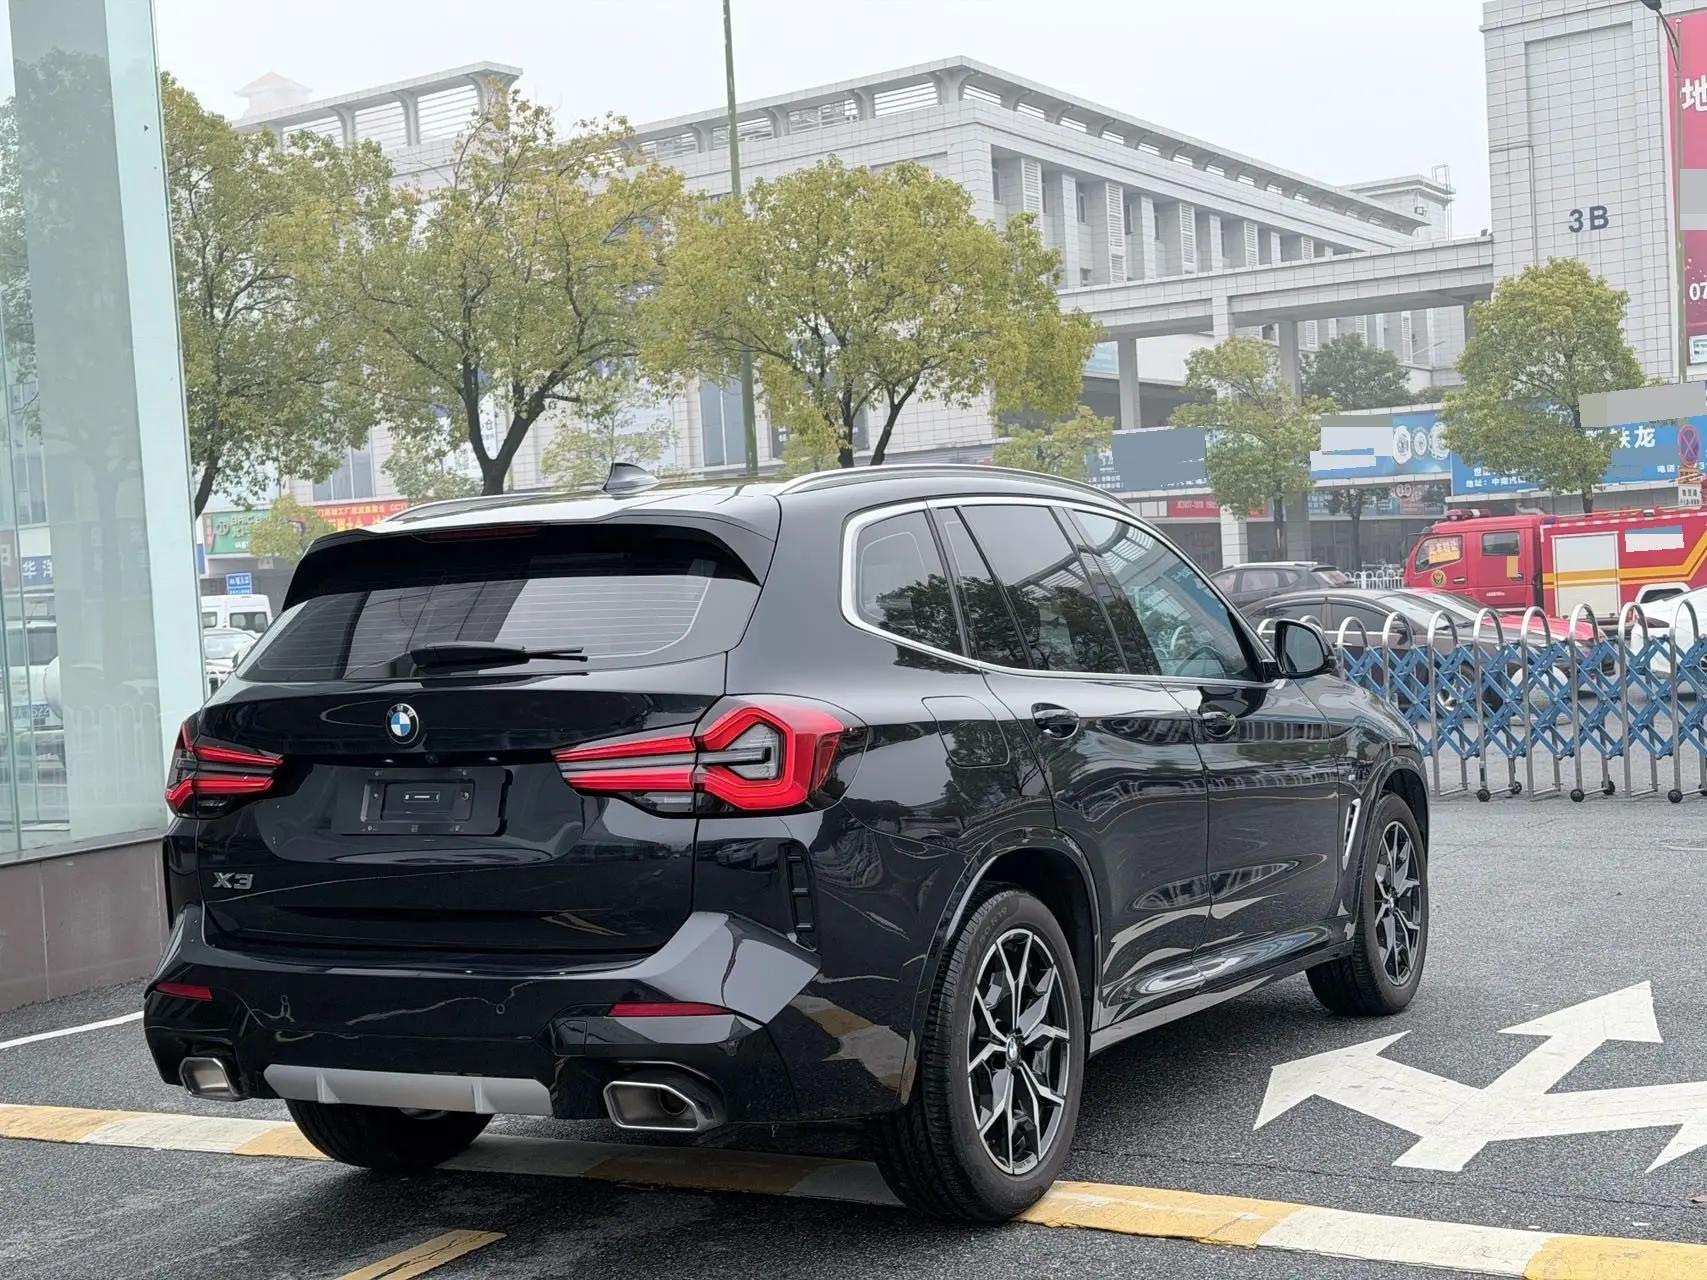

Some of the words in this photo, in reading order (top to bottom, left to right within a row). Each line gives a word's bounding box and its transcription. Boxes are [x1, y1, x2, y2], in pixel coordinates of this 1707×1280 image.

[1681, 75, 1707, 111] 地
[1569, 205, 1609, 233] 3B
[212, 871, 254, 890] X3
